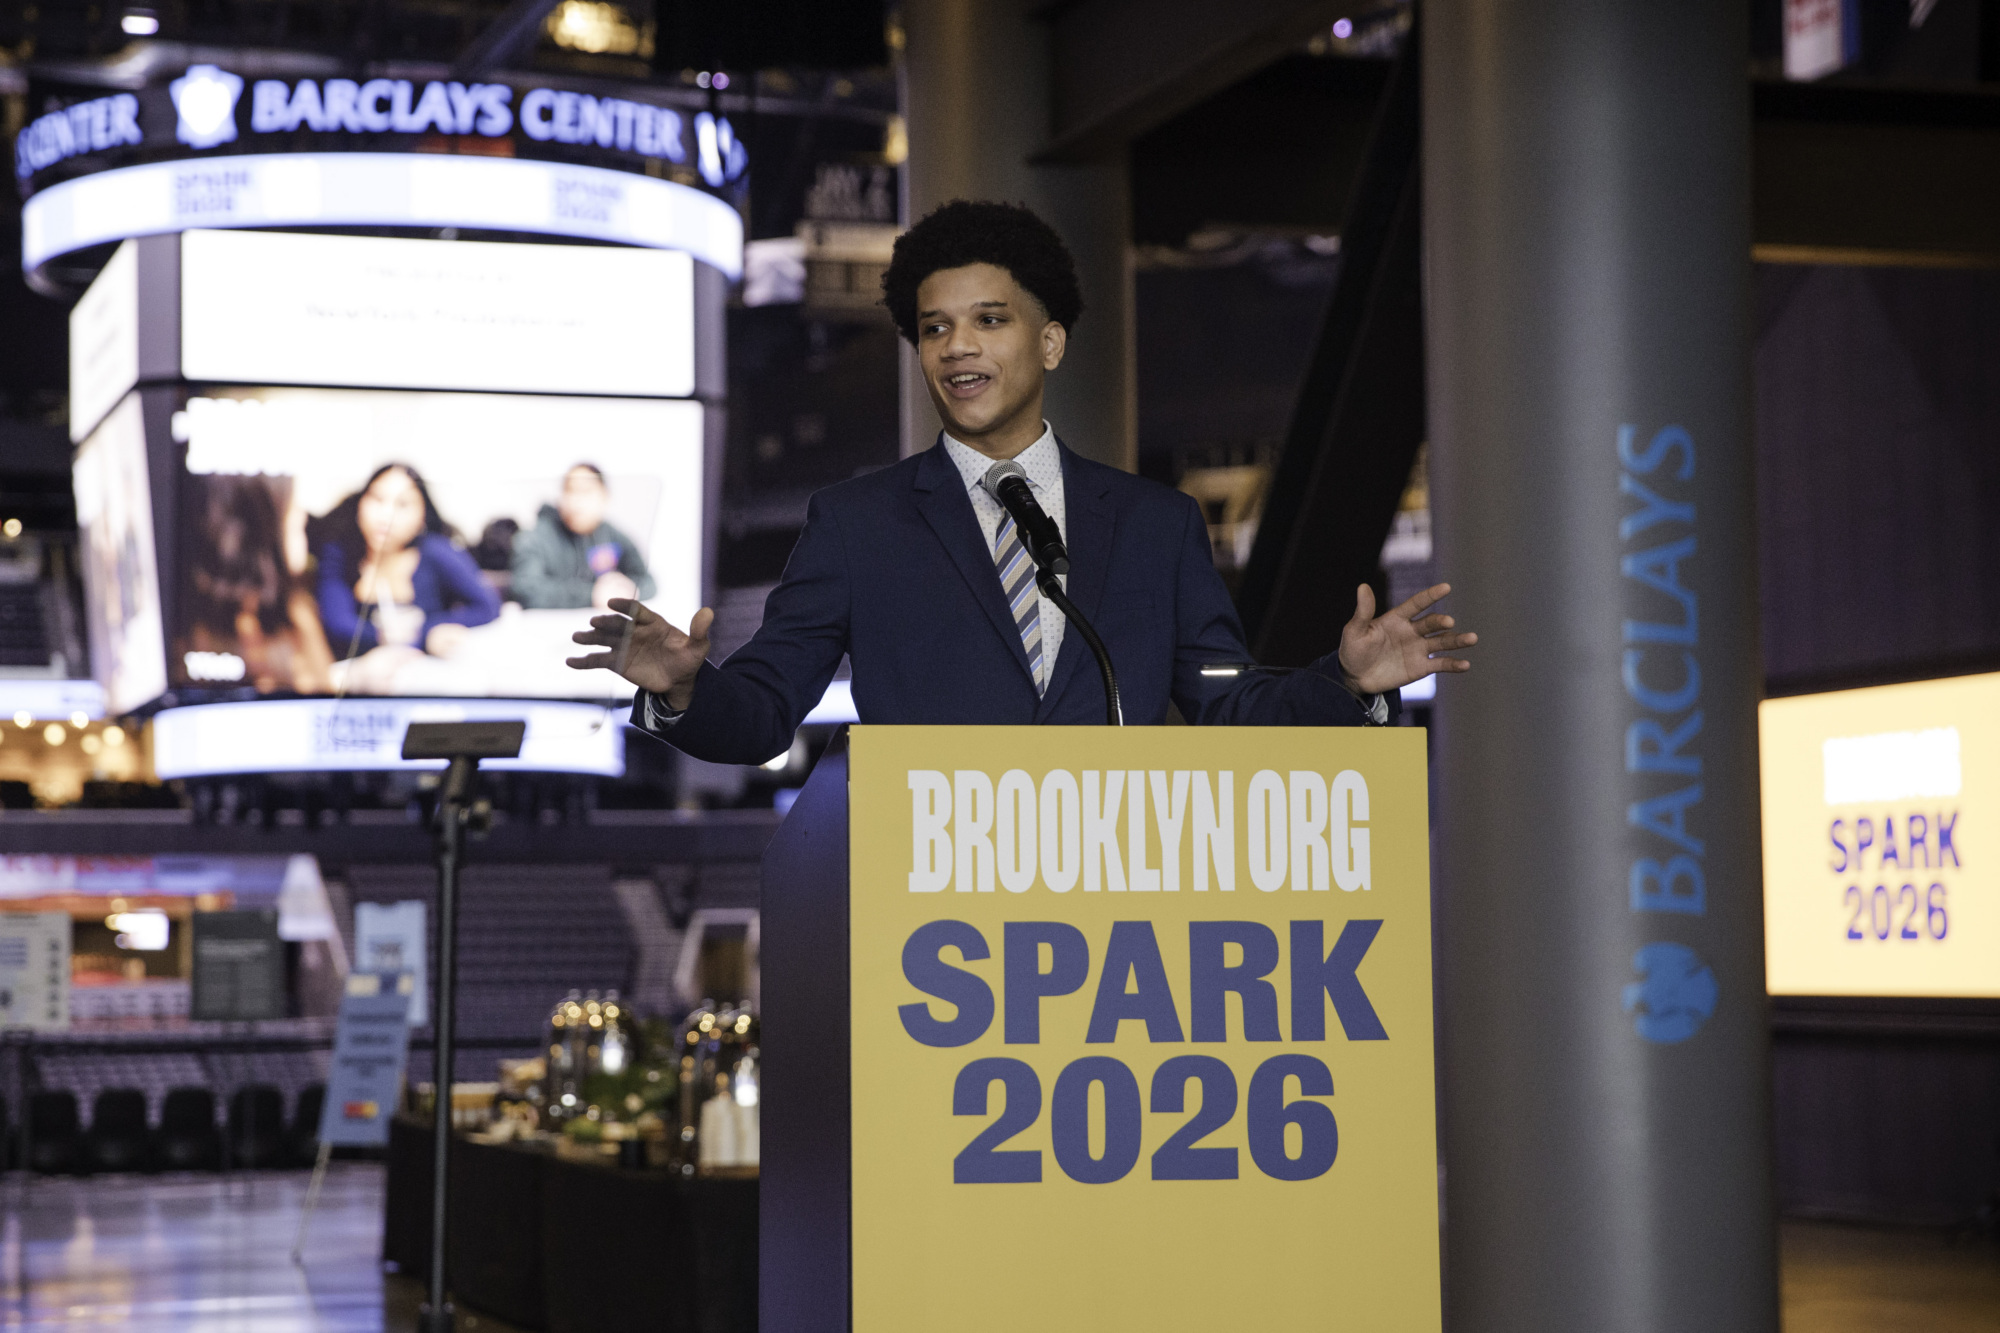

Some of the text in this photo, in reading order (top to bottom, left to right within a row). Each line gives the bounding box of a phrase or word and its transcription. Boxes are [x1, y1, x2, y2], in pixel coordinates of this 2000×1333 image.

[28, 93, 142, 169] CENTER
[252, 79, 686, 163] BARCLAYS CENTER
[1617, 423, 1706, 915] BARCLAYS
[907, 769, 1372, 893] BROOKLYN ORG
[1830, 812, 1961, 873] SPARK
[1844, 883, 1948, 940] 2026
[897, 919, 1391, 1048] SPARK
[952, 1054, 1340, 1185] 2026
